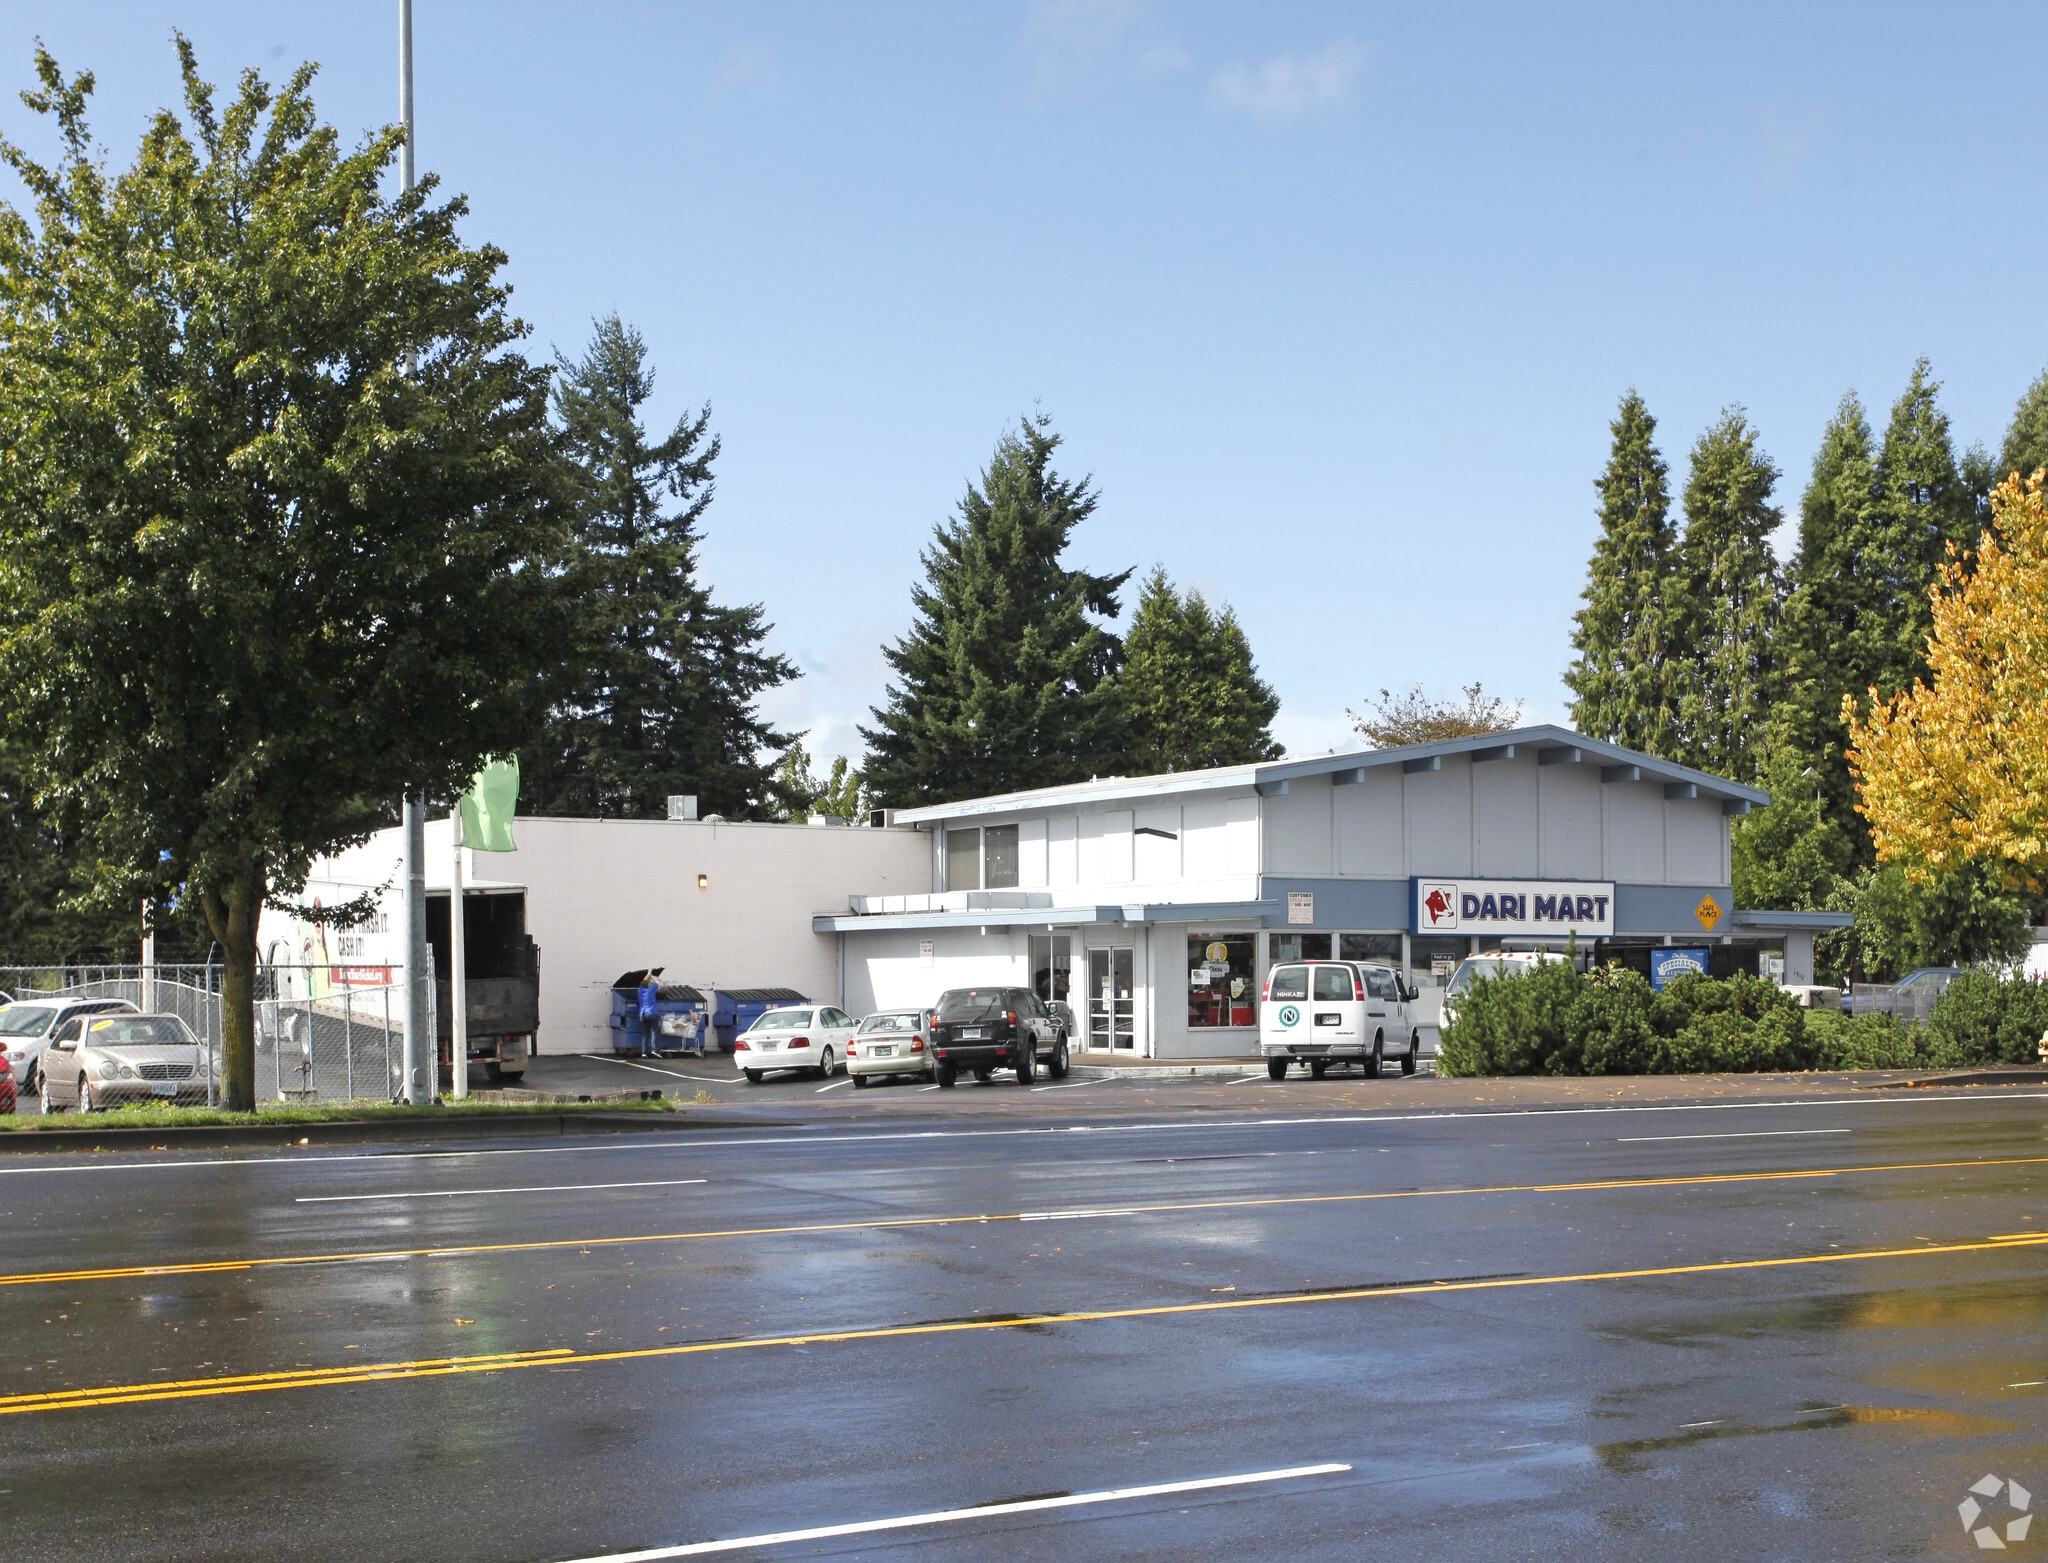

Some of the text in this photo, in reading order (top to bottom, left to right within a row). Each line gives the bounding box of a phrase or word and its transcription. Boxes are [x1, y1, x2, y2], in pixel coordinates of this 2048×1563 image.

[1461, 892, 1609, 922] DARI MART
[338, 936, 354, 957] CASH
[1661, 960, 1699, 970] SPECIALTY
